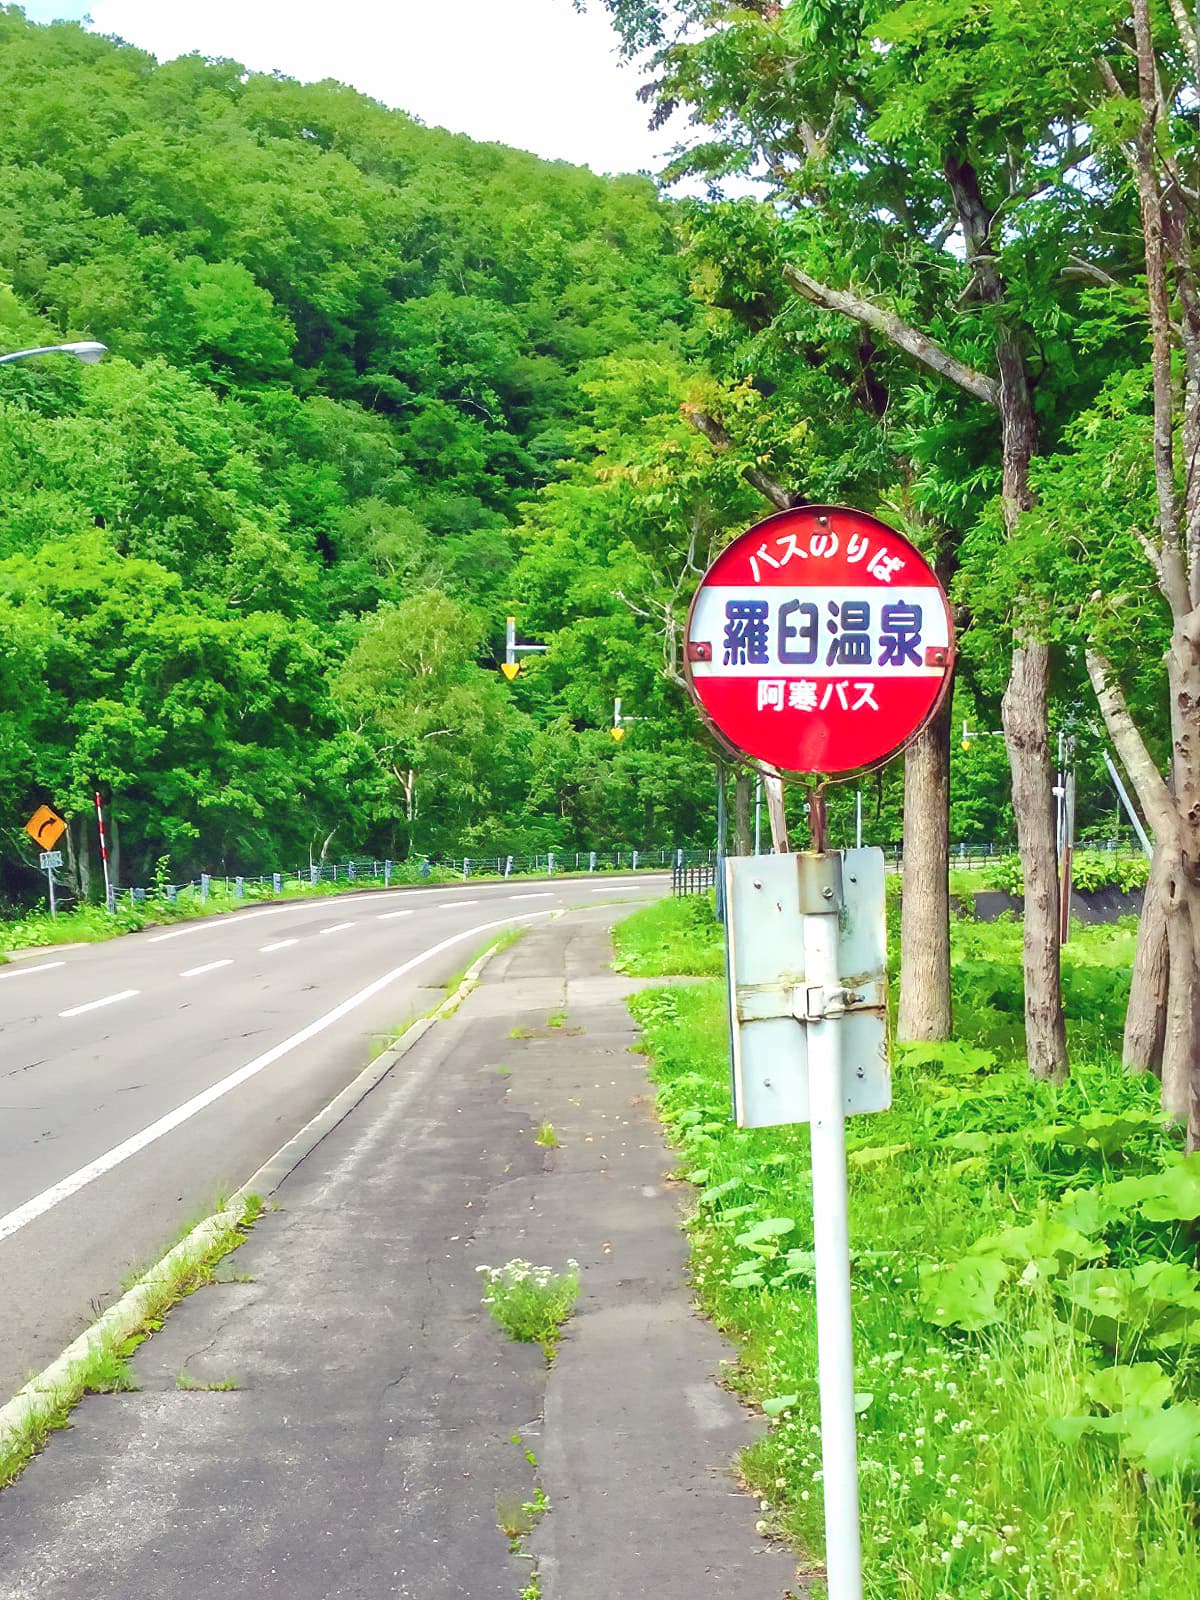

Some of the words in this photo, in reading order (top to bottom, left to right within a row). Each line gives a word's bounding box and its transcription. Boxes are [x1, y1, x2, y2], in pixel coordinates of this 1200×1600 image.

[748, 533, 905, 582] バスのりば
[723, 599, 923, 667] 羅臼温泉
[757, 679, 879, 711] 阿寒バス
